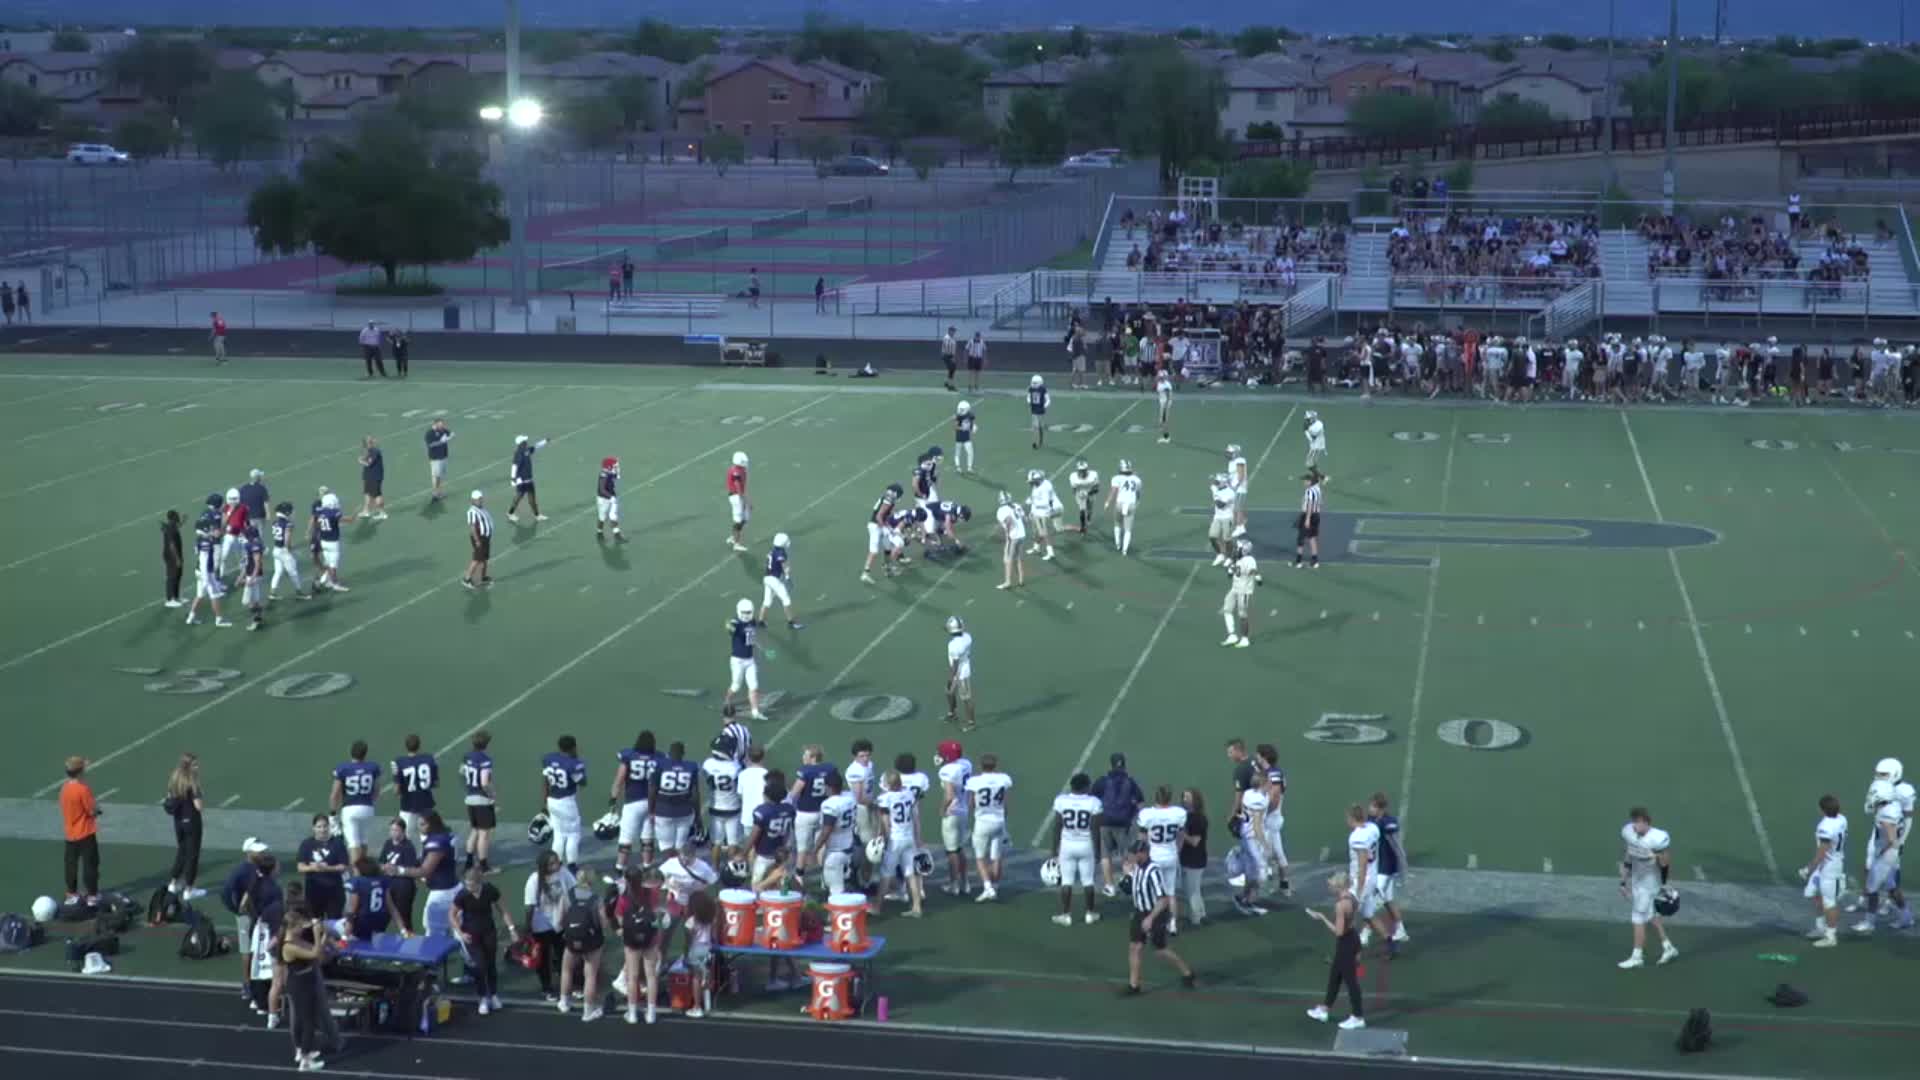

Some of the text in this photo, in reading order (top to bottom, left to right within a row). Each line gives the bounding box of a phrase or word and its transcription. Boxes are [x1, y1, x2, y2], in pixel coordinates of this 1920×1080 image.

[345, 774, 373, 795] 59
[403, 763, 431, 792] 79
[660, 771, 691, 791] 65
[978, 786, 1006, 807] 34
[1062, 809, 1090, 829] 28
[1151, 823, 1178, 844] 35
[370, 887, 383, 913] 6
[725, 911, 738, 926] G
[767, 910, 783, 927] G
[837, 913, 852, 931] G
[818, 980, 834, 997] G
